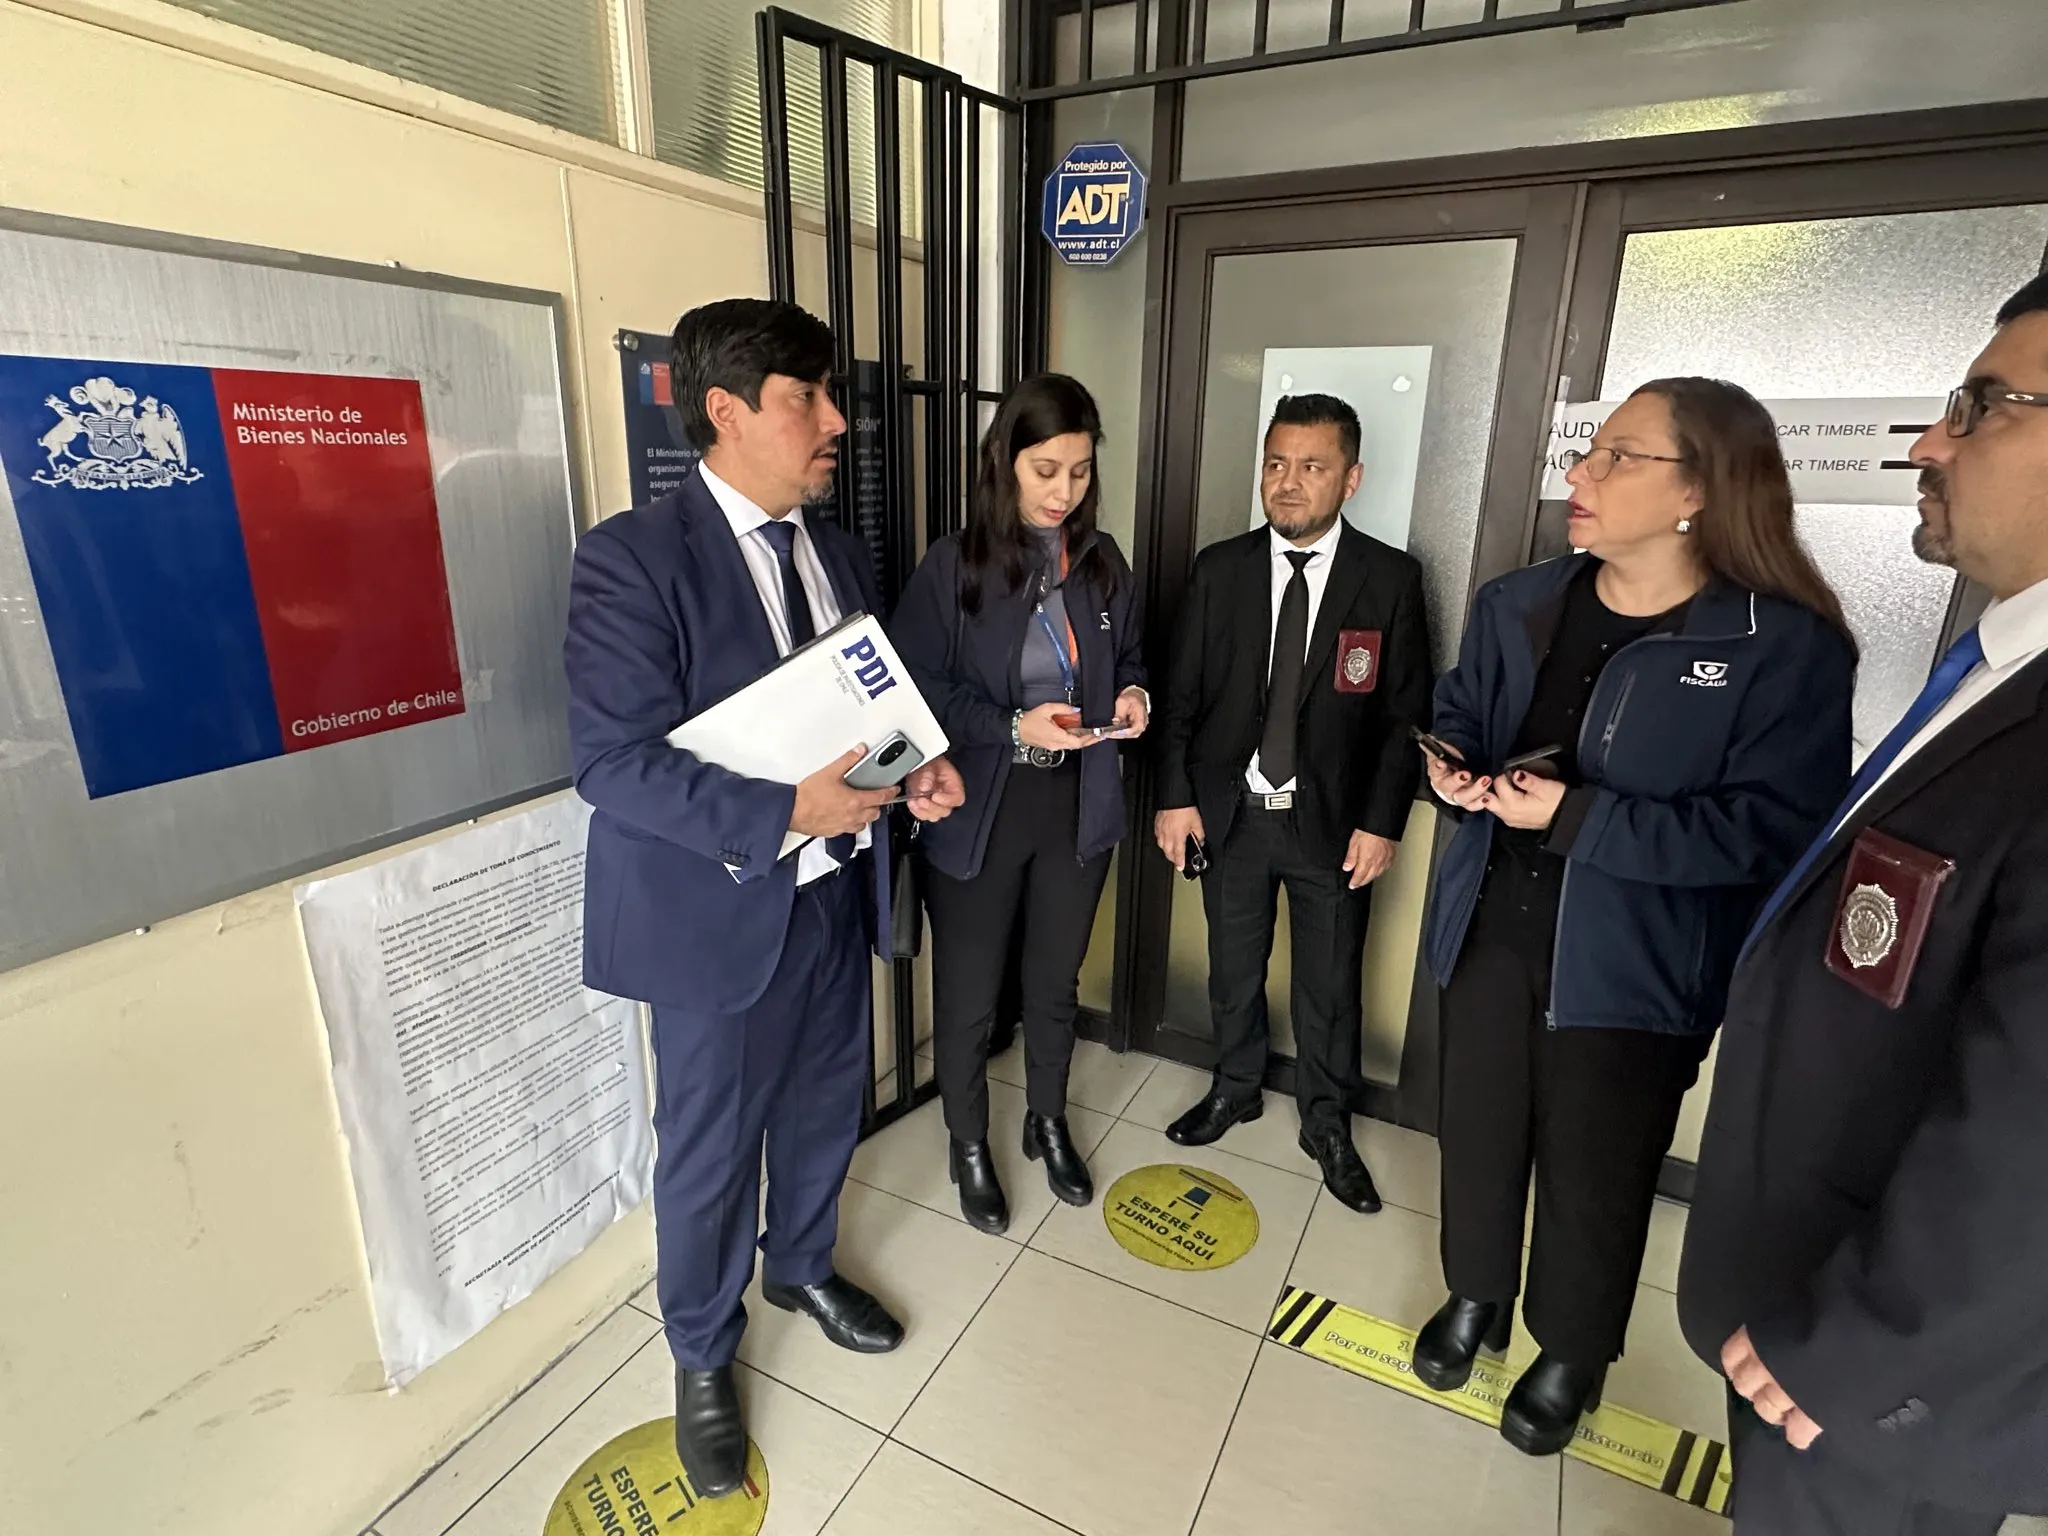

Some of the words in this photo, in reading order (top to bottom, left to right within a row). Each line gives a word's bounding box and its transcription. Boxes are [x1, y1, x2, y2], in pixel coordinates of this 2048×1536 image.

[1065, 160, 1109, 172] Protegido
[1111, 161, 1127, 171] por
[1058, 183, 1129, 225] ADT
[1058, 239, 1120, 250] www.adt.cl
[233, 402, 333, 423] Ministerio
[338, 406, 362, 424] de
[238, 427, 305, 445] Bienes
[312, 429, 408, 446] Nacionales
[1776, 424, 1811, 436] CAR
[1816, 423, 1878, 437] TIMBRE
[656, 448, 691, 458] Ministerio
[648, 464, 687, 475] organismo
[1808, 459, 1870, 471] TIMBRE
[841, 635, 897, 700] PDI
[291, 705, 381, 737] Gobierno
[387, 698, 409, 716] de
[413, 689, 457, 709] Chile
[431, 870, 479, 892] DECLARACIÓN
[479, 866, 488, 874] DE
[489, 859, 506, 870] TOMA
[507, 856, 515, 864] DE
[516, 839, 561, 860] CONOCIMIENTO
[1115, 1201, 1169, 1236] TURNO
[1170, 1235, 1216, 1261] AQUÍ
[1129, 1195, 1192, 1233] ESPERE
[1193, 1229, 1218, 1246] SU
[1325, 1331, 1357, 1351] Por
[1358, 1343, 1378, 1359] su
